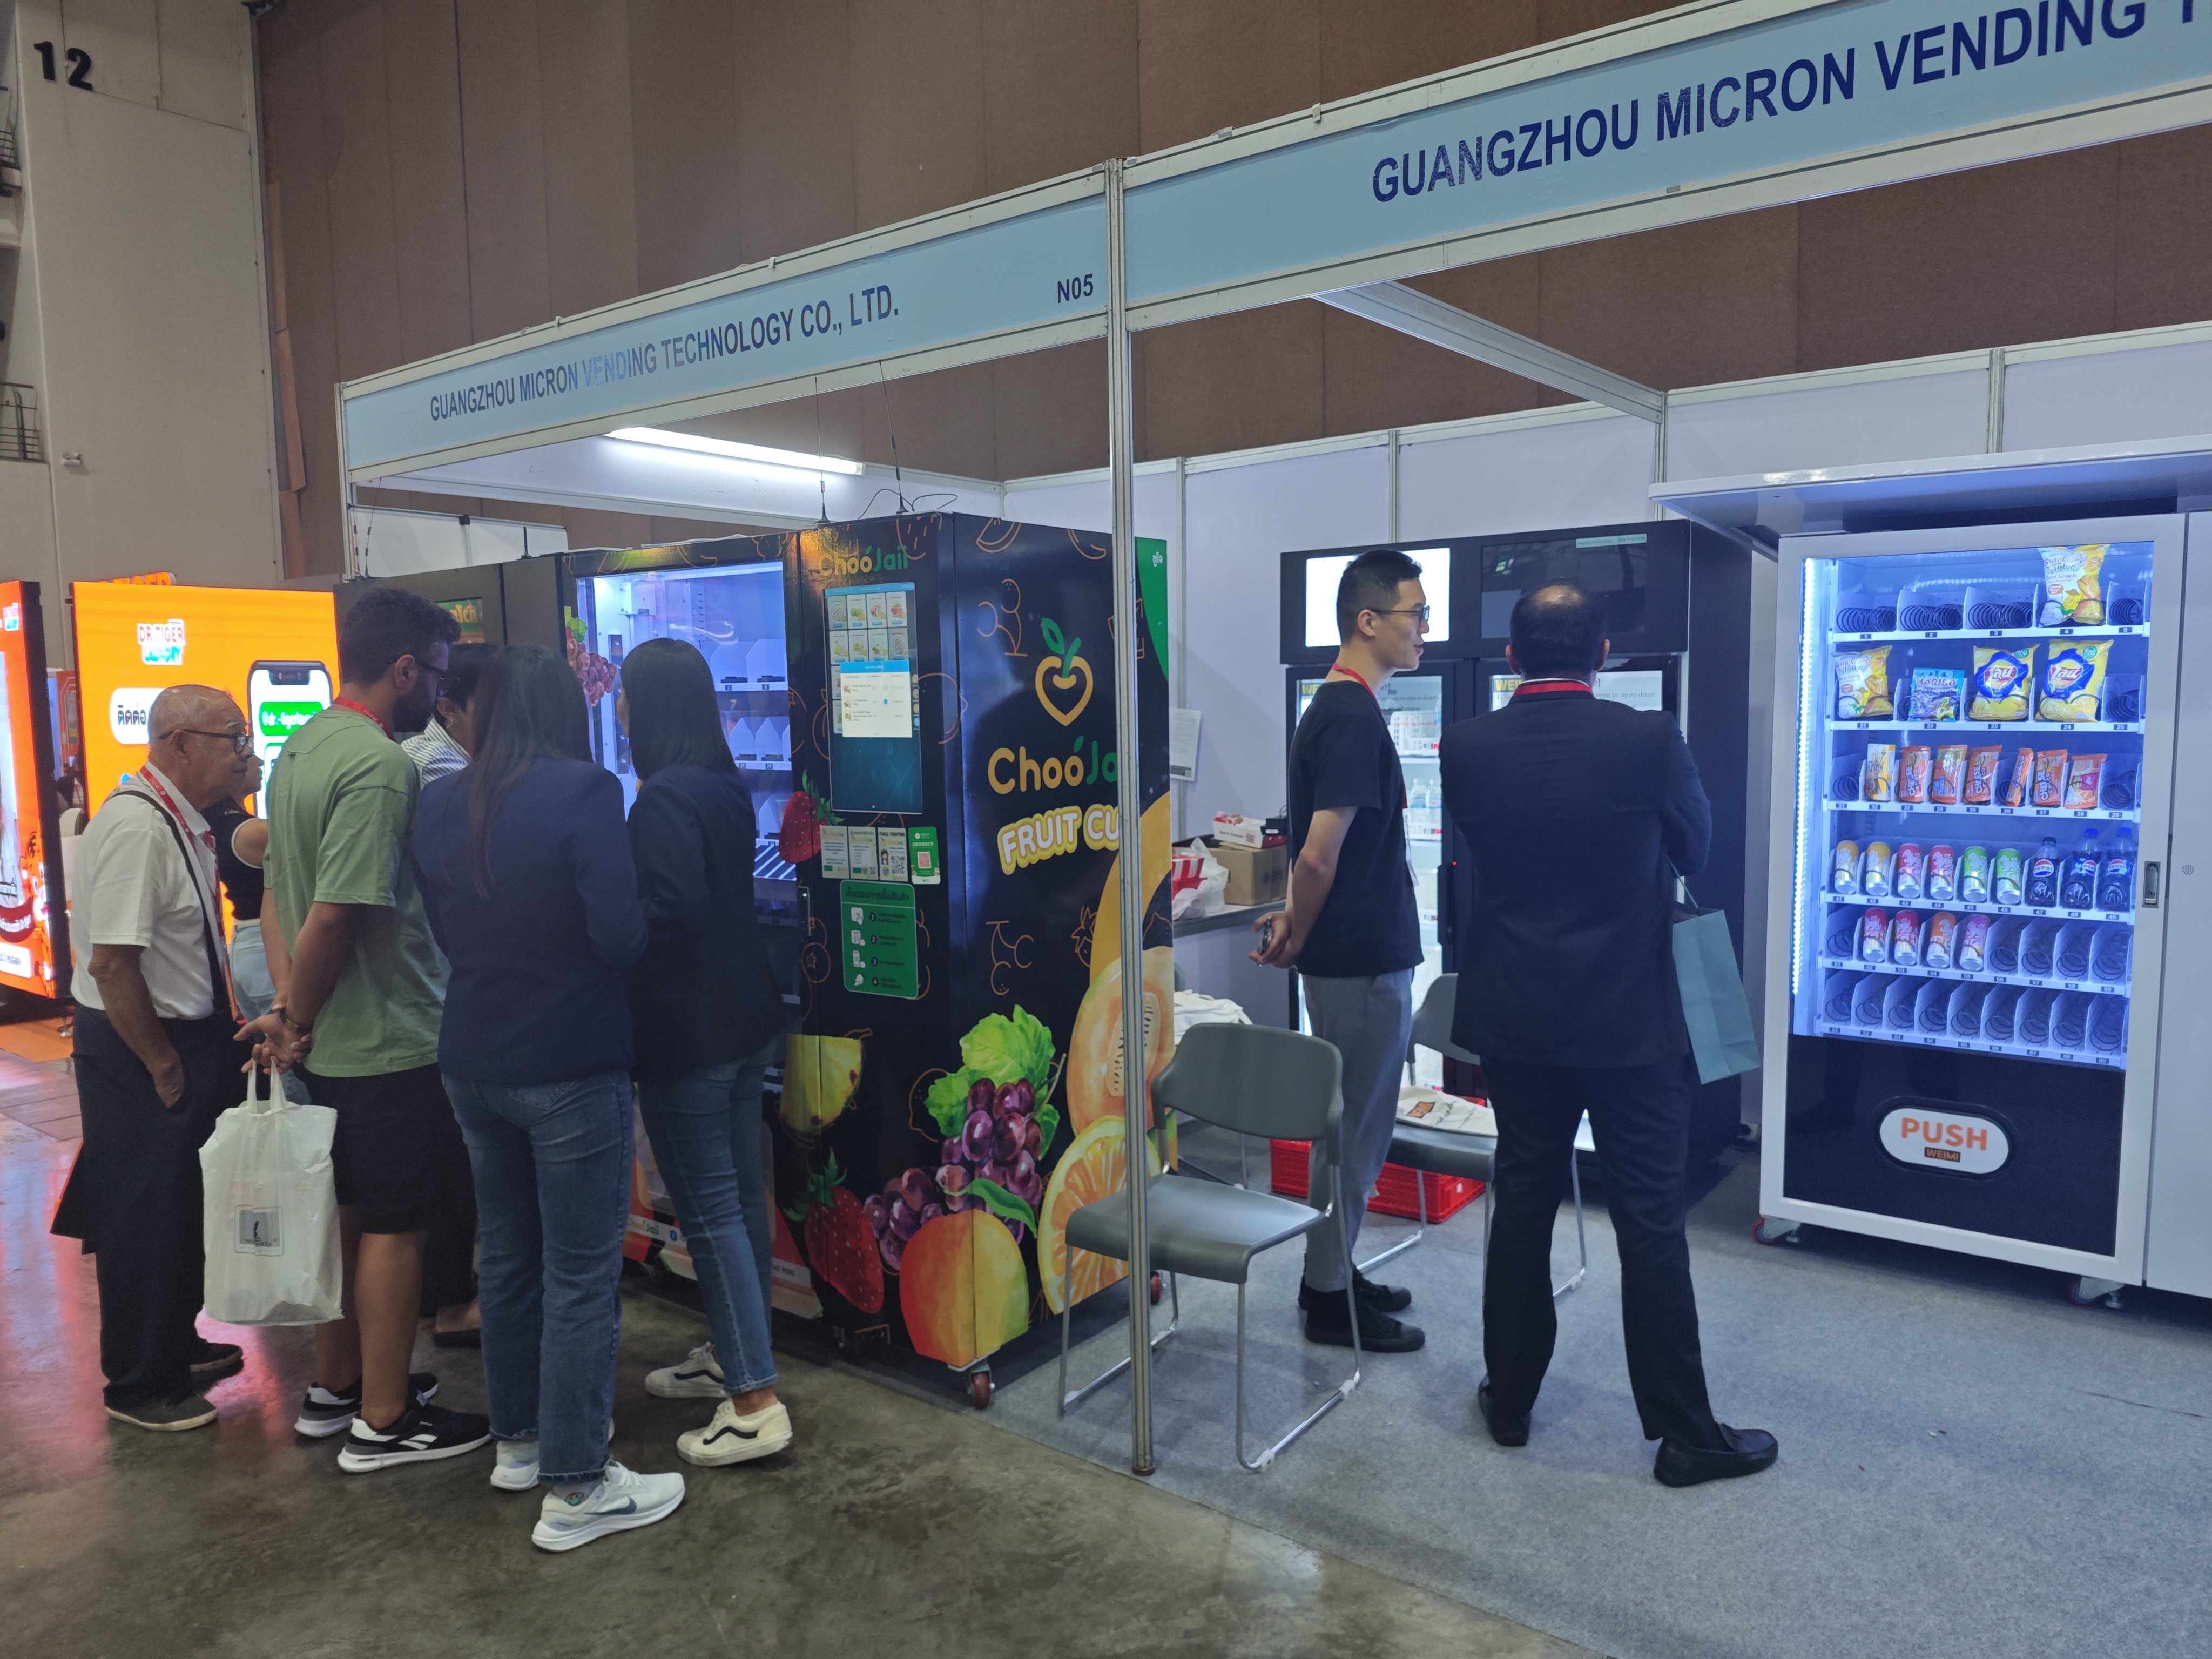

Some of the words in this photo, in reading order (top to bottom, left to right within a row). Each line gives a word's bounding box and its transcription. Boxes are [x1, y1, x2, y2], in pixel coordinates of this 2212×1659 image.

[33, 41, 92, 91] 12
[1372, 99, 1638, 203] GUANGZHOU
[1656, 48, 1856, 141] MICRON
[1874, 0, 2147, 91] VENDING
[1057, 273, 1094, 304] N05
[430, 377, 515, 421] GUANGZHOU
[520, 362, 579, 402] MICRON
[582, 343, 657, 387] VENDING
[661, 308, 794, 369] TECHNOLOGY
[800, 300, 842, 338] CO.,
[849, 285, 899, 326] LTD.
[139, 626, 184, 643] DR.TIGER
[1495, 679, 1522, 691] WEI
[988, 737, 1118, 794] ChooJa
[1001, 811, 1079, 865] FRUIT
[1087, 810, 1120, 841] CU
[1900, 1116, 1988, 1151] PUSH
[1926, 1148, 1959, 1161] WEIMI
